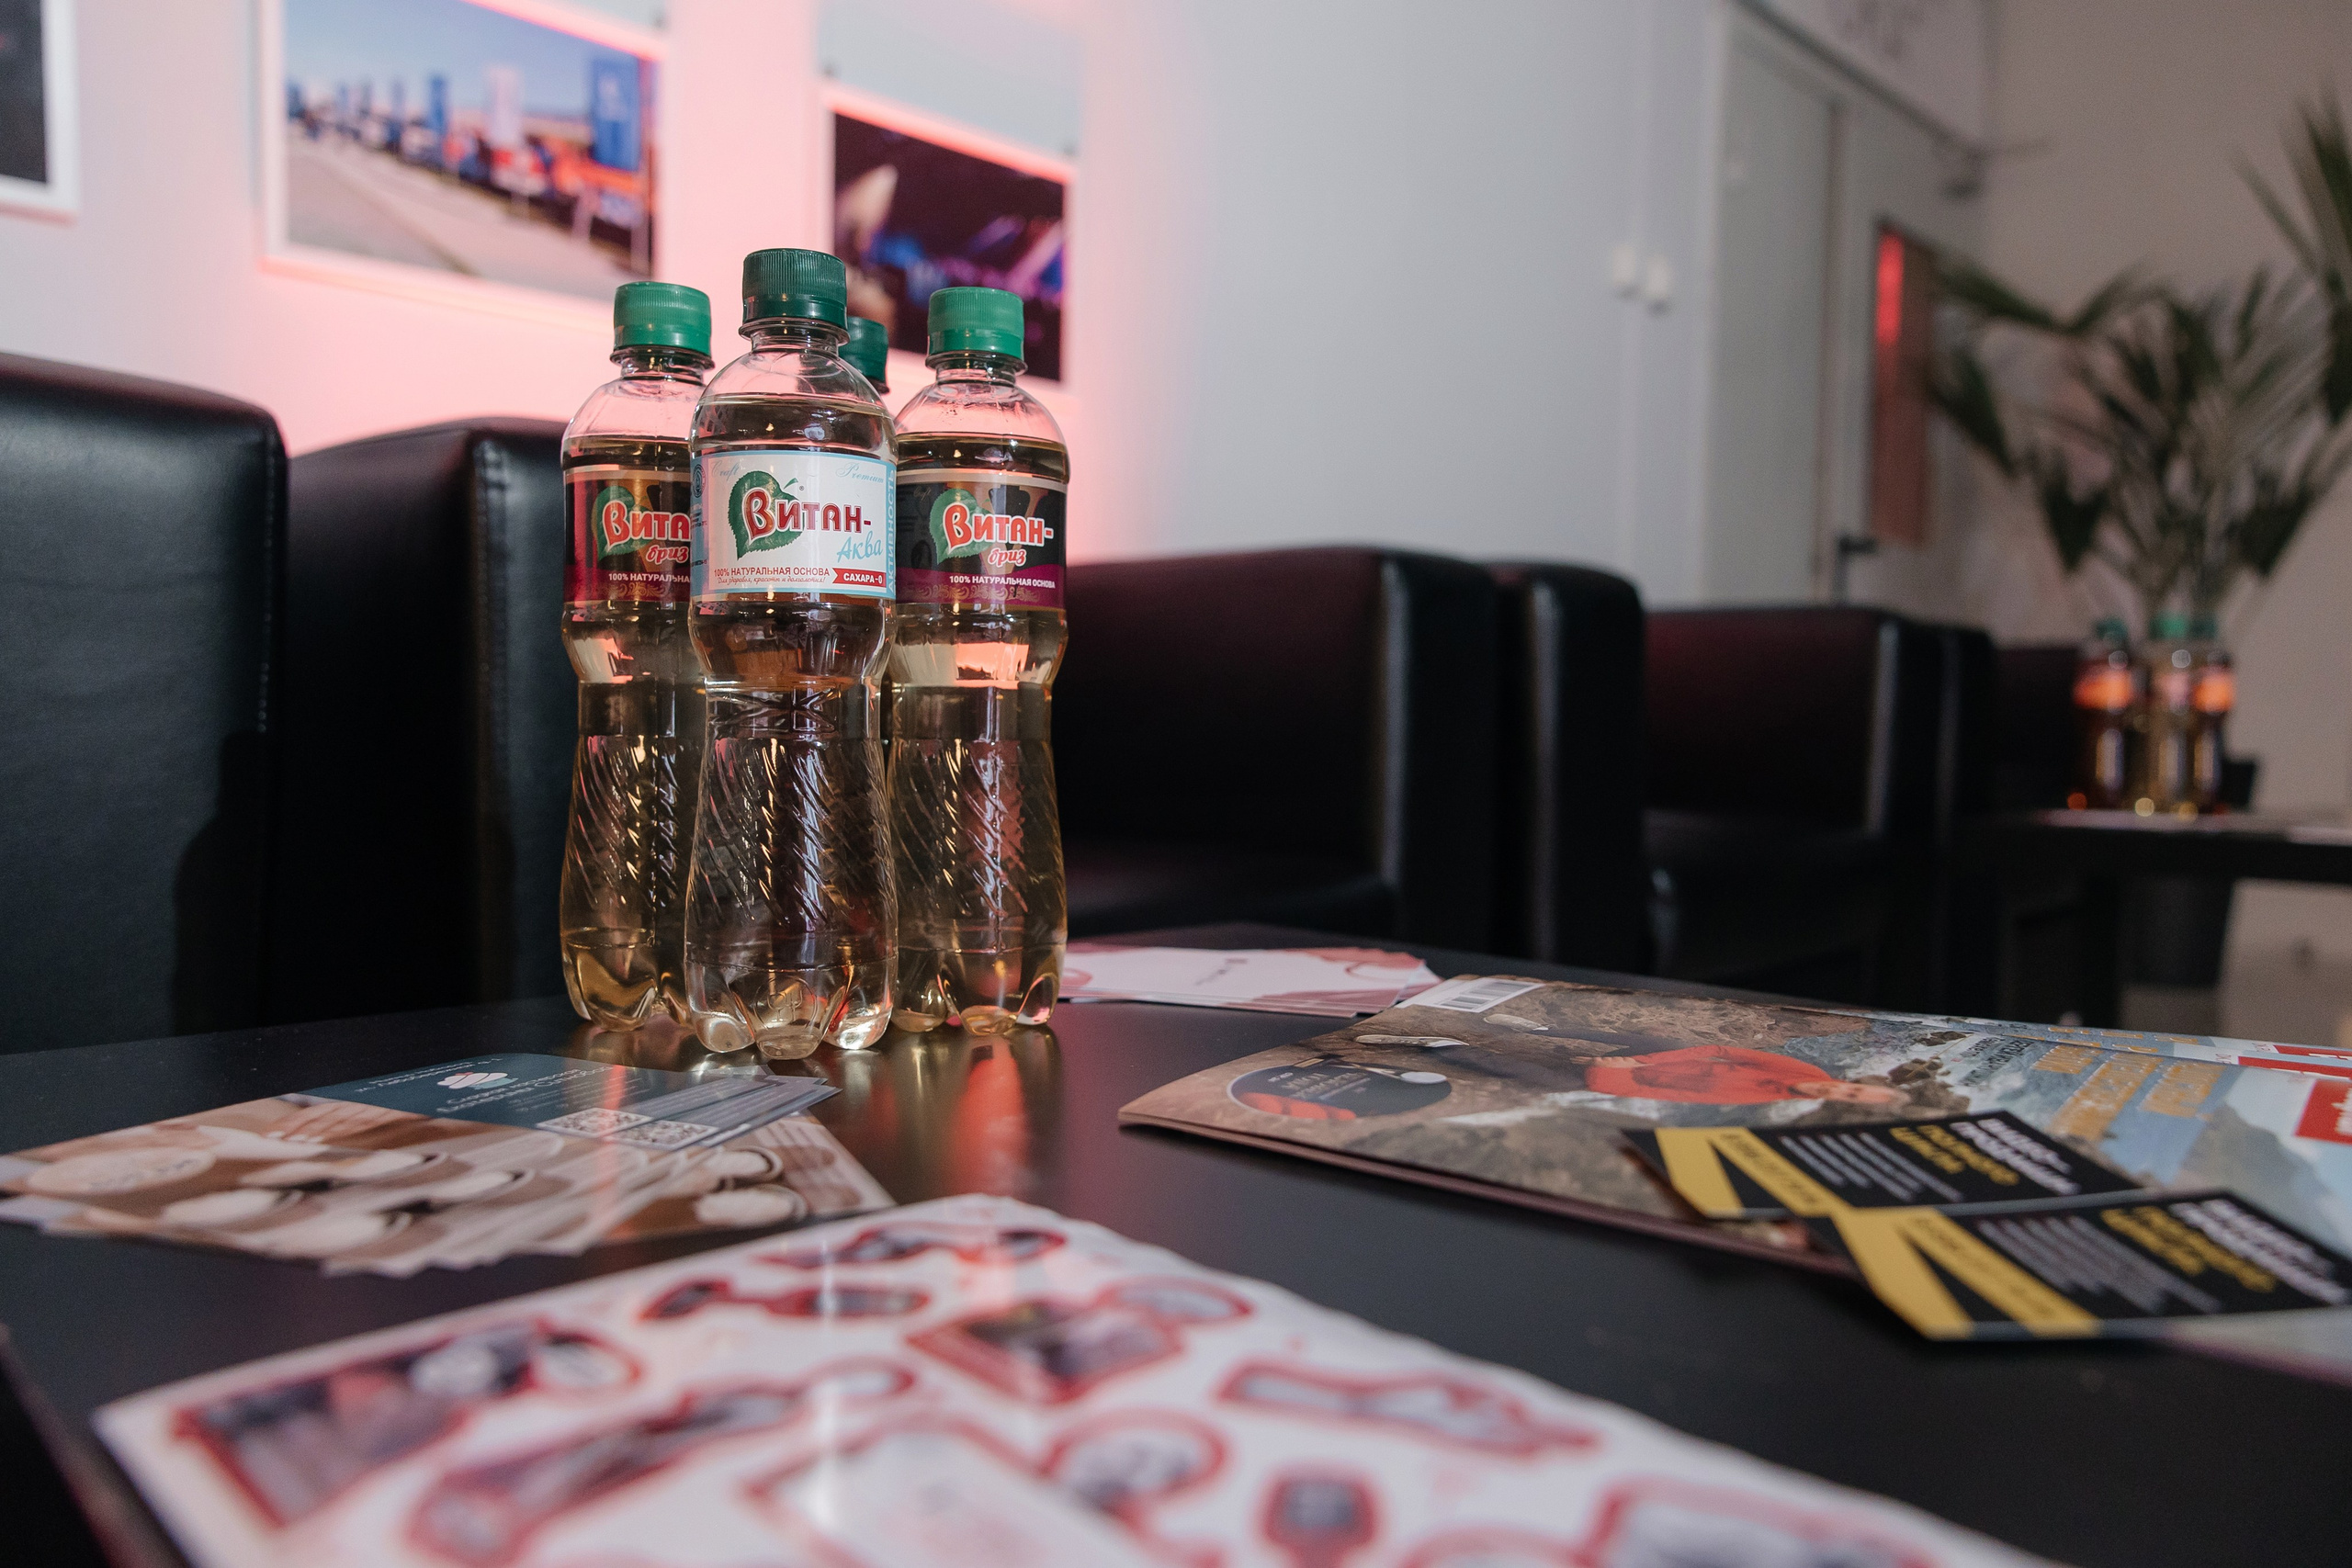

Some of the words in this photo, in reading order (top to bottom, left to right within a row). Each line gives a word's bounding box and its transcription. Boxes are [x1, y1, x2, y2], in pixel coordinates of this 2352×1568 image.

[835, 462, 885, 484] Premium
[887, 469, 895, 592] АКТИВНОСТЬ
[646, 545, 689, 565] бриз
[837, 531, 883, 563] Аква
[988, 547, 1027, 567] бриз
[608, 573, 629, 581] 100%
[714, 569, 729, 577] 100%
[730, 567, 791, 577] НАТУРАЛЬНАЯ
[793, 567, 831, 577] ОСНОВА
[949, 575, 971, 584] 100%
[972, 576, 1032, 587] НАТУРАЛЬНАЯ
[1032, 579, 1056, 589] ОСНОВА
